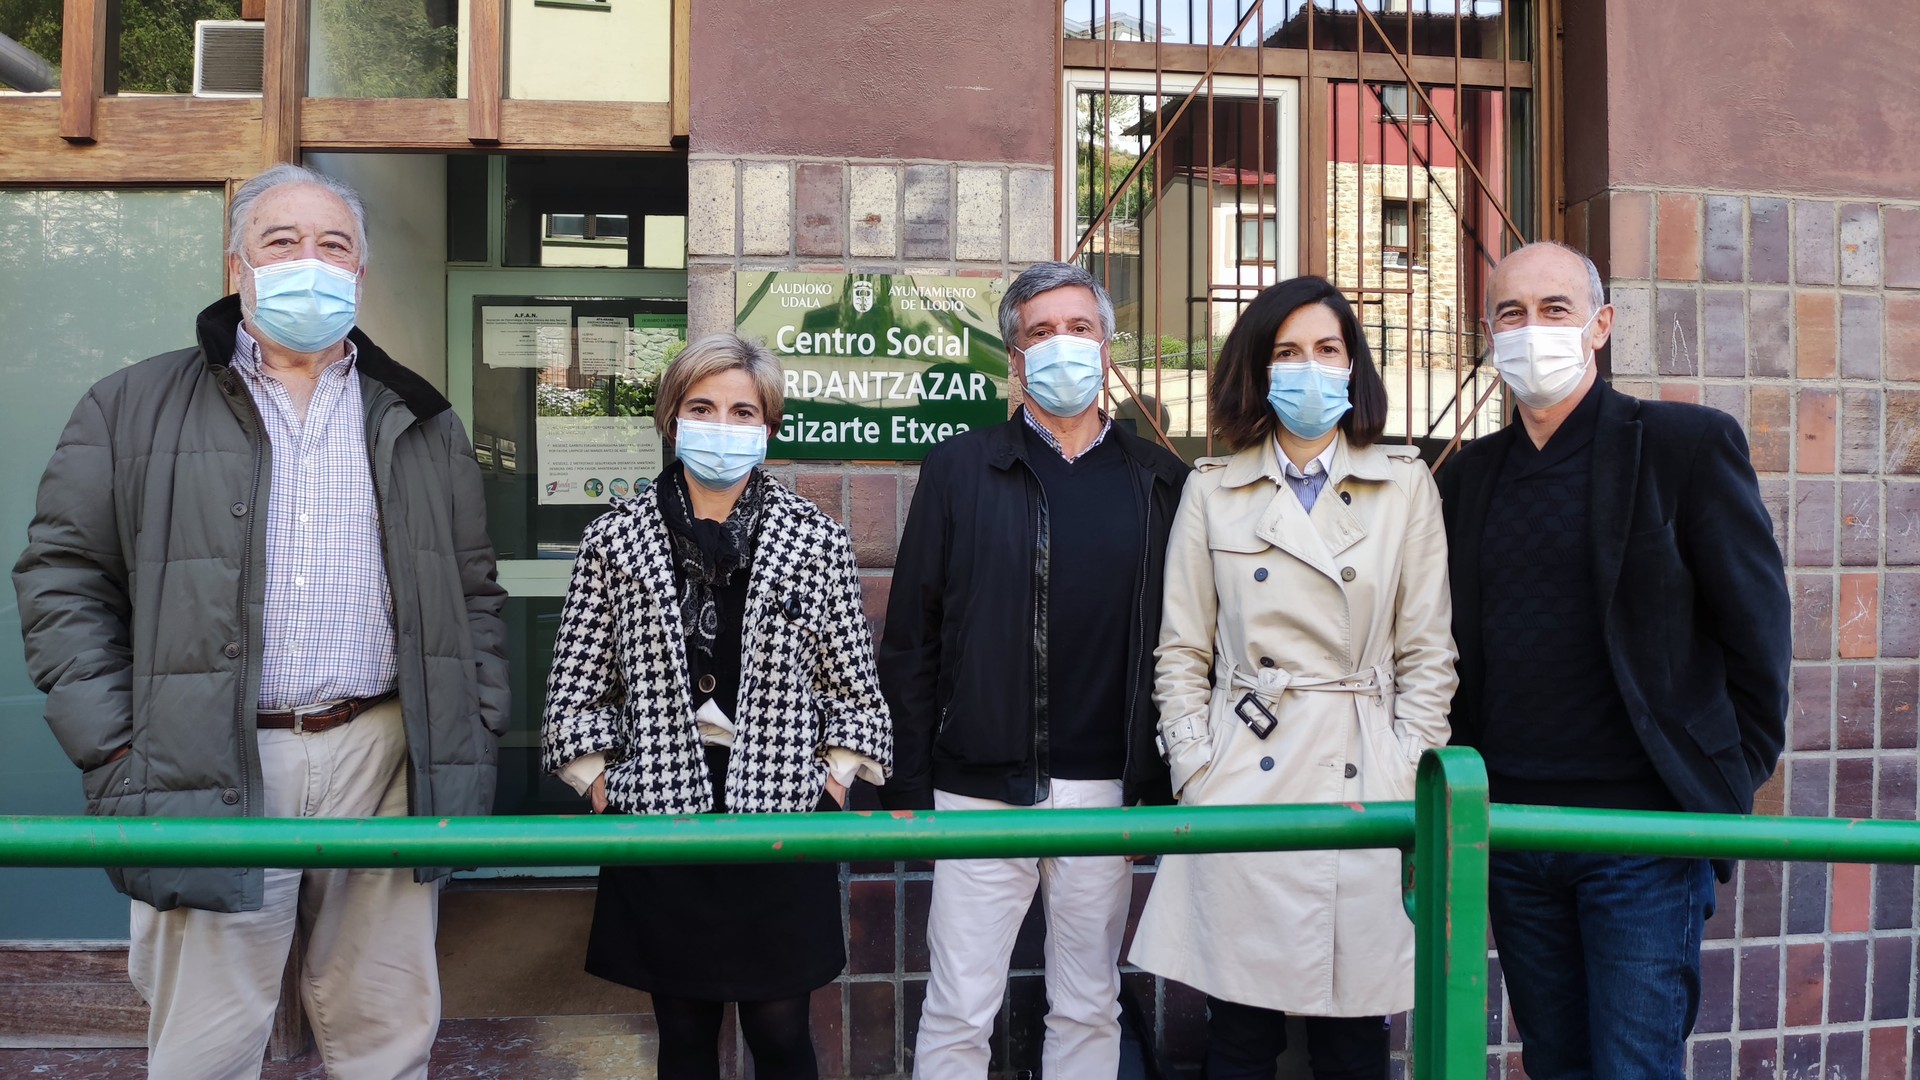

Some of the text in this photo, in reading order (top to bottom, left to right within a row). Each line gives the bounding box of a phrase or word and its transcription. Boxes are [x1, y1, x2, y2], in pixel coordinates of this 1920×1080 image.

[769, 283, 832, 295] LAUDIOKO
[888, 285, 977, 299] AYUNTAMIENTO
[781, 297, 821, 308] UDALA
[901, 299, 964, 312] DE LLODIO
[776, 325, 969, 357] Centro Social
[783, 369, 987, 401] RDANTZAZAR
[776, 413, 880, 444] Gizarte
